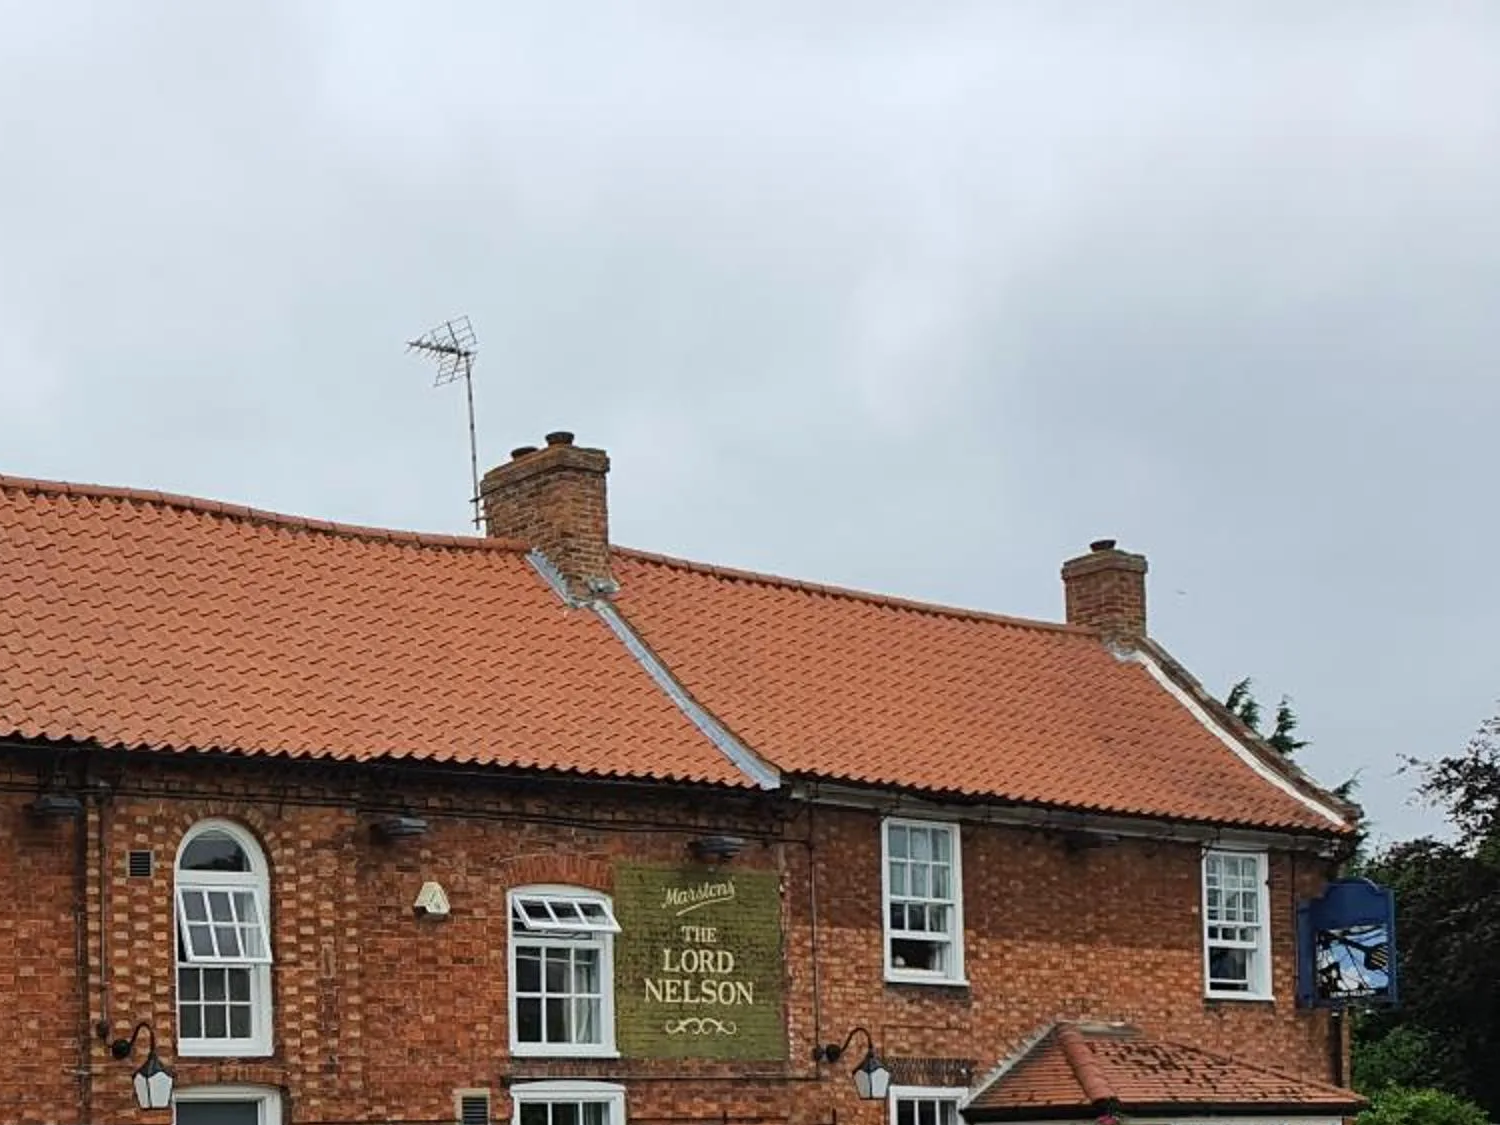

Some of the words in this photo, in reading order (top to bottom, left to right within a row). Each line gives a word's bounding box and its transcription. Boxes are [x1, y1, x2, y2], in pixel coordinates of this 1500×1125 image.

[681, 925, 717, 943] THE
[662, 948, 735, 974] LORD
[643, 977, 754, 1005] NELSON
